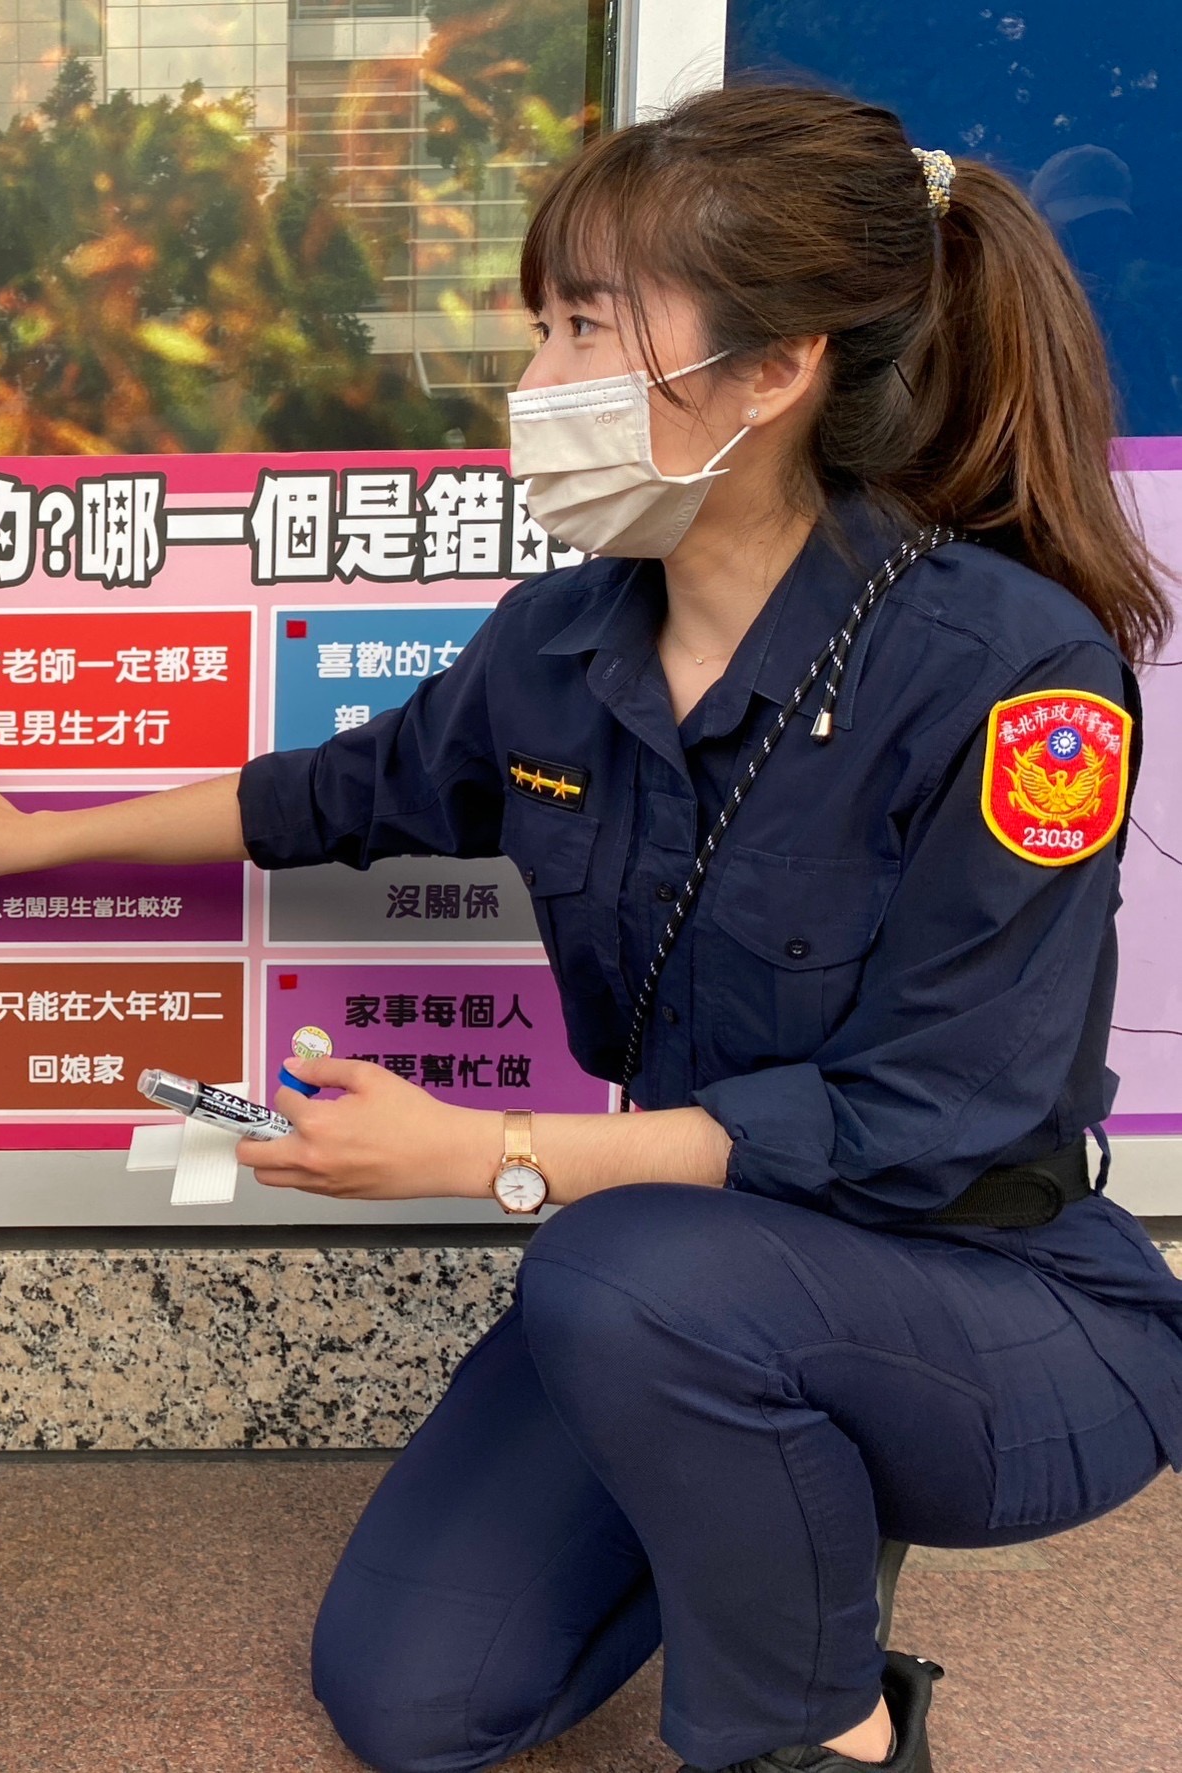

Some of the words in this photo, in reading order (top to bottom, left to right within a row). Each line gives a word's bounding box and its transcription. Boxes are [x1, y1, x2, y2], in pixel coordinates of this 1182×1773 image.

[999, 702, 1120, 755] 臺北市政府警察局
[1022, 826, 1084, 850] 23038
[386, 884, 499, 919] 沒關係
[344, 994, 533, 1029] 家事每個人
[29, 1055, 124, 1085] 回娘家
[270, 1124, 288, 1134] PILOT
